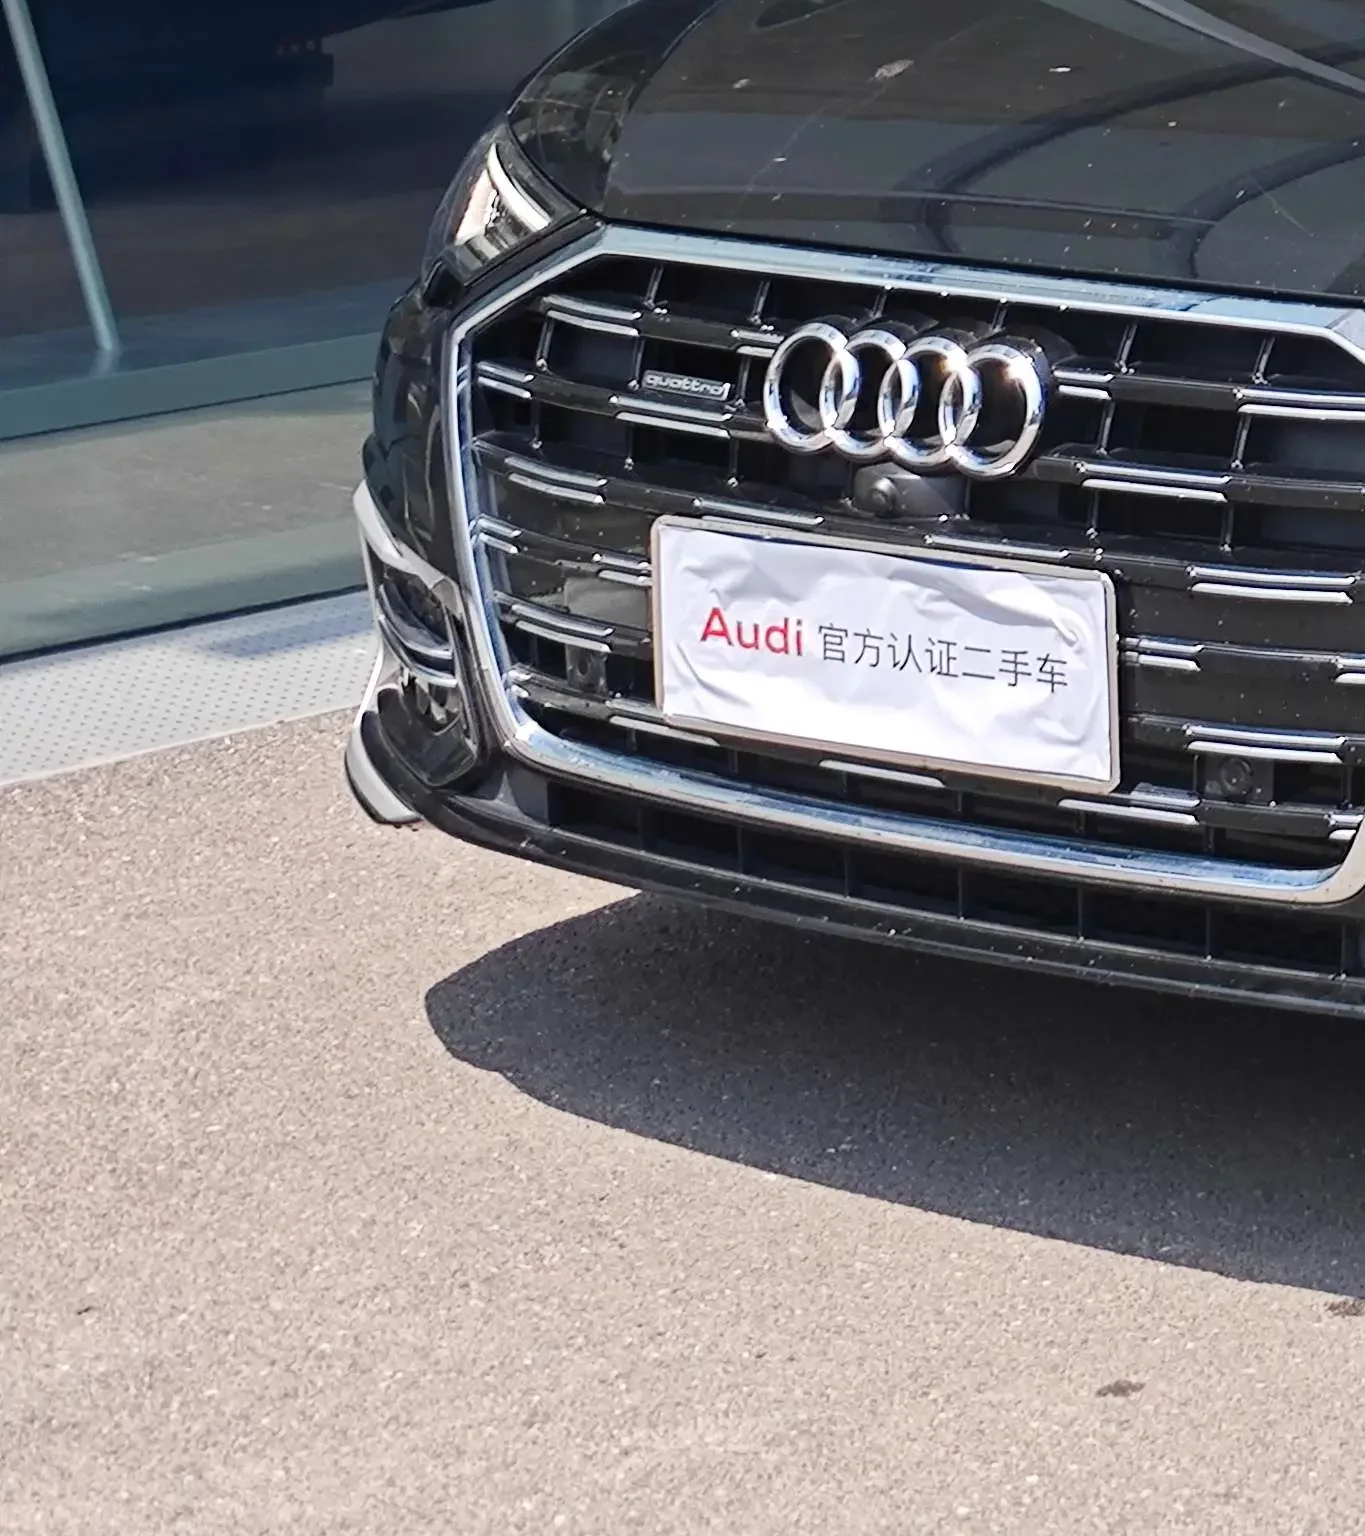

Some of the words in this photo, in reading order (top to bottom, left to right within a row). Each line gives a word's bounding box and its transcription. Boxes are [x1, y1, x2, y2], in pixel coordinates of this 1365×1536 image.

[645, 373, 725, 396] quattro
[700, 607, 803, 656] Audi
[818, 623, 1069, 694] 官方认证二手车
